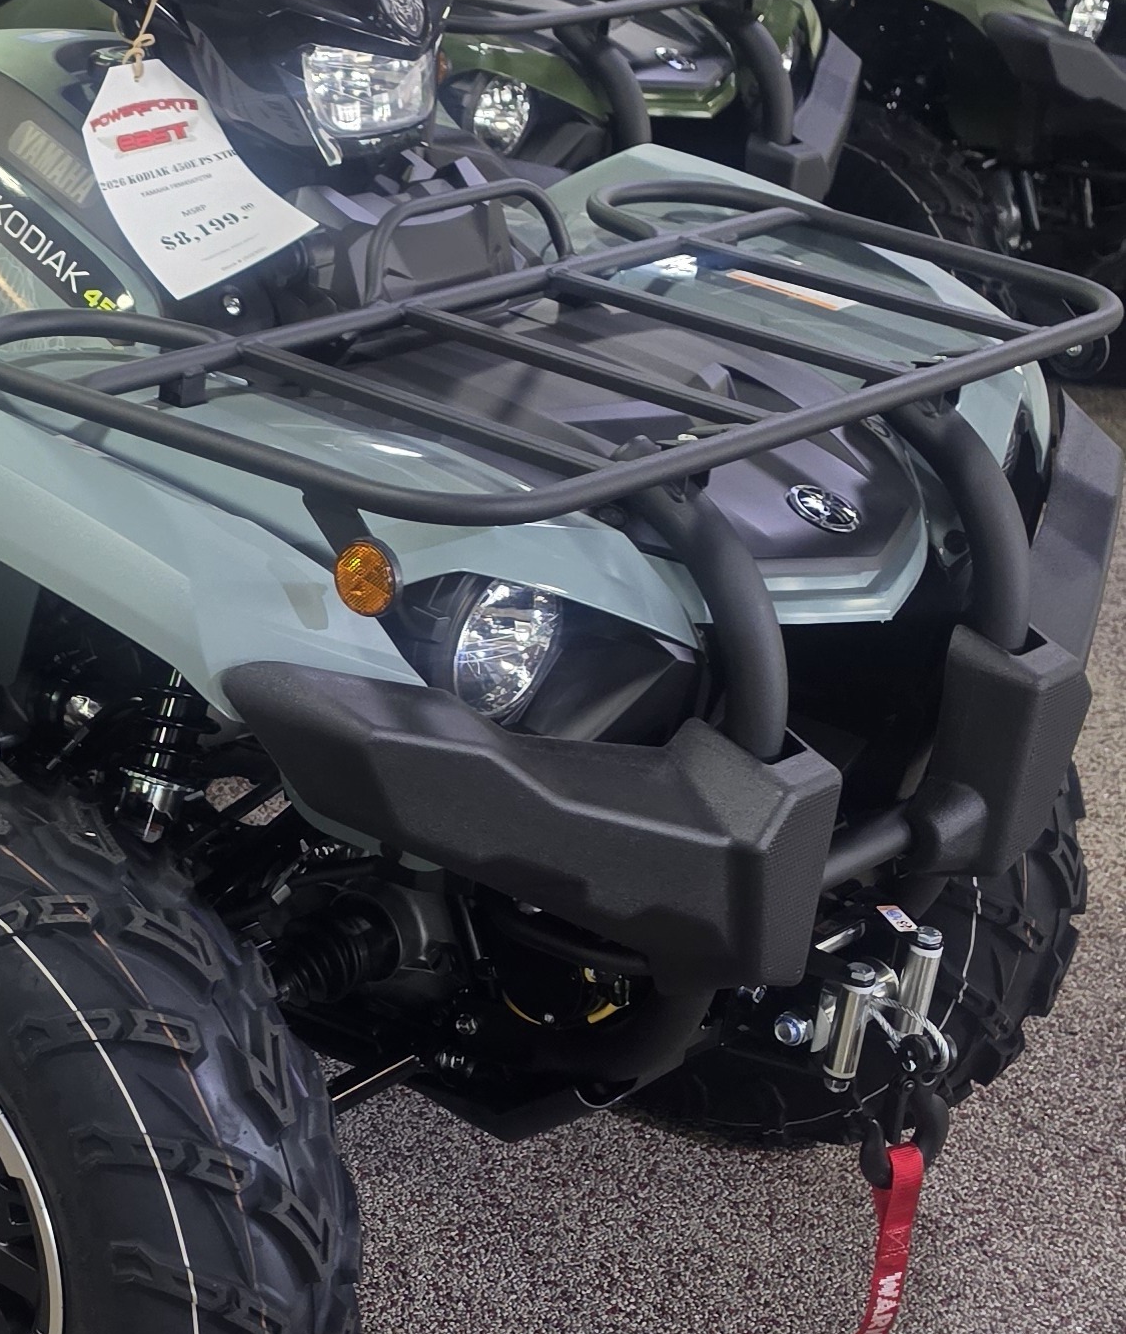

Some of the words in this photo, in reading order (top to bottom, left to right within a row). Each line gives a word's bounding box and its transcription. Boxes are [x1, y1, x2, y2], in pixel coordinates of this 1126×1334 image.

[89, 97, 199, 132] POWERSPORTS
[15, 126, 96, 204] YAMAHA
[100, 177, 127, 191] 2026
[127, 165, 171, 186] KODIAK
[198, 155, 214, 168] PS
[181, 204, 207, 217] MSRP
[83, 289, 121, 311] 45
